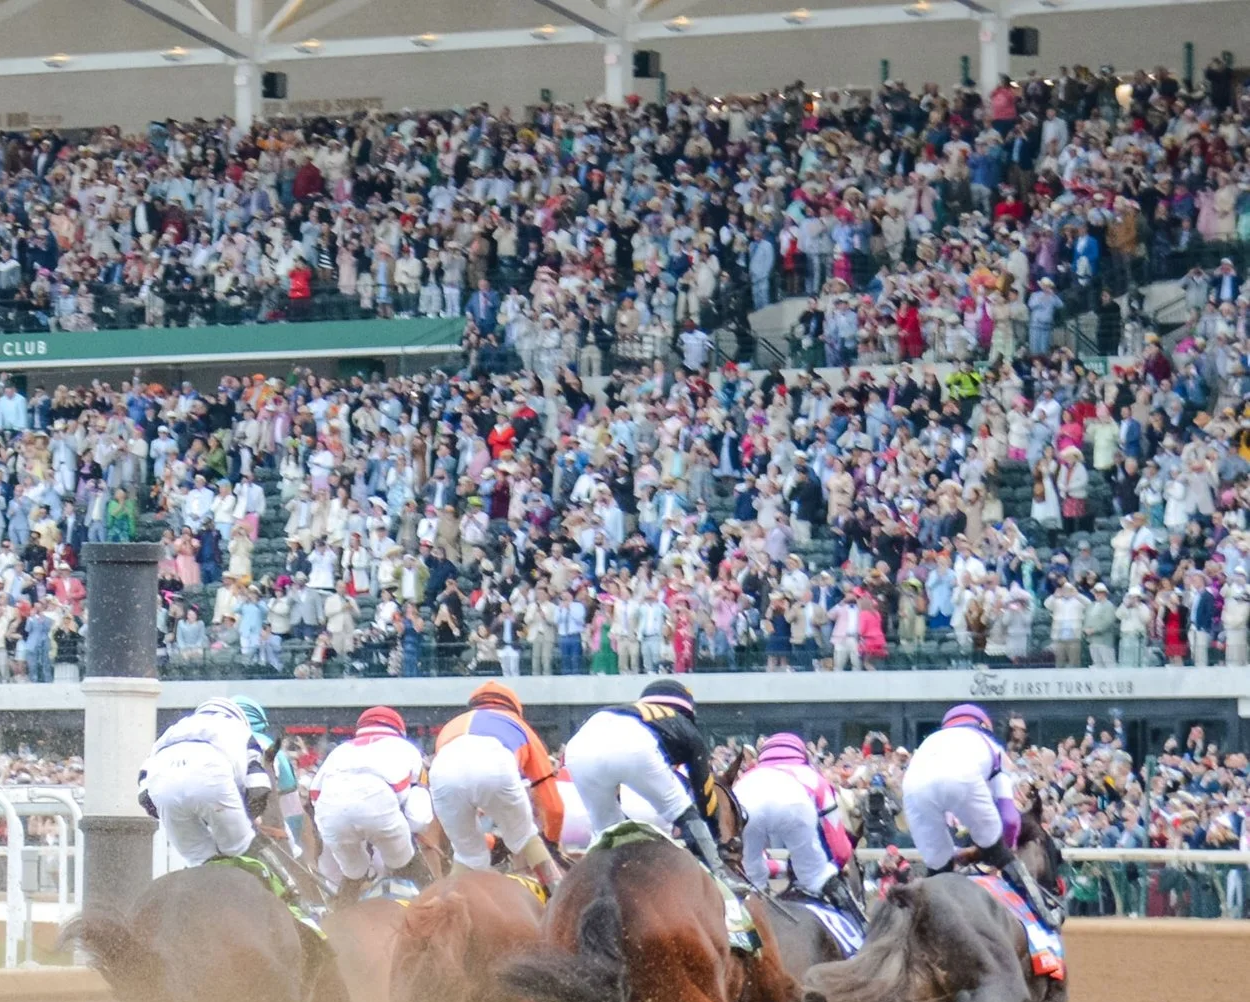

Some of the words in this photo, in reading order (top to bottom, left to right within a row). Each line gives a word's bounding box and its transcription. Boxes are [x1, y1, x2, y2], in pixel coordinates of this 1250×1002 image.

[3, 340, 47, 356] CLUB
[969, 672, 1007, 696] Ford
[1013, 682, 1050, 695] FIRST
[1057, 681, 1093, 694] TURN
[1100, 681, 1134, 694] CLUB
